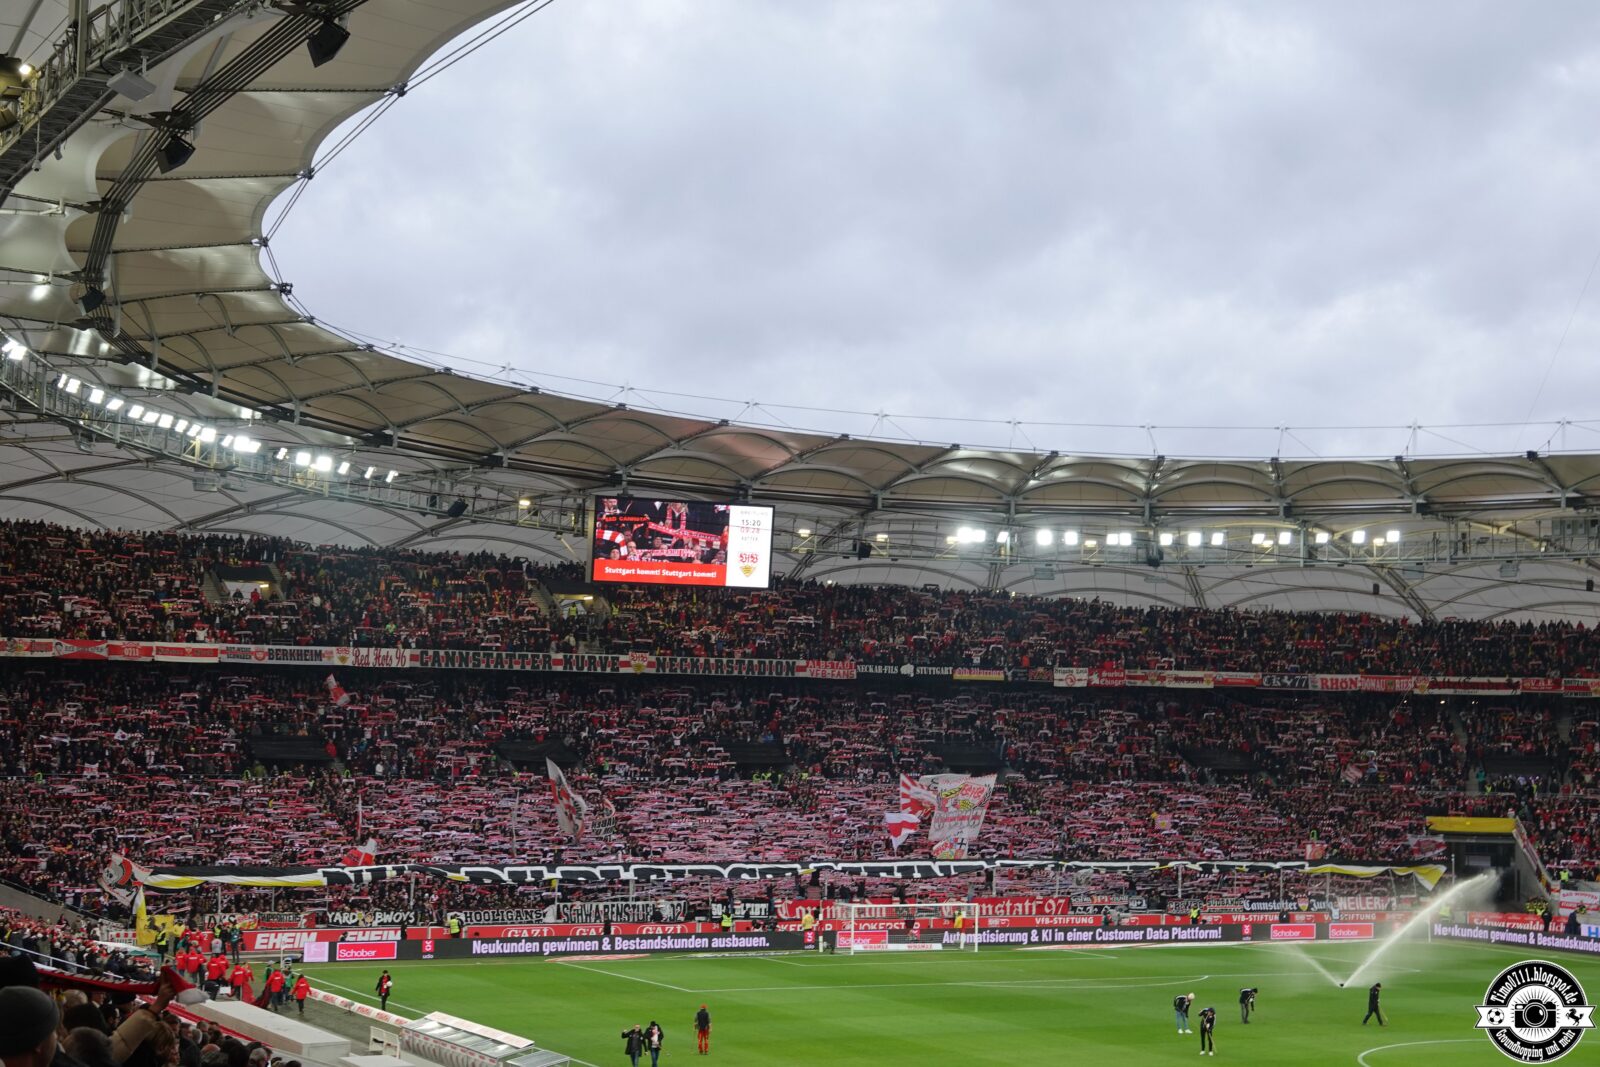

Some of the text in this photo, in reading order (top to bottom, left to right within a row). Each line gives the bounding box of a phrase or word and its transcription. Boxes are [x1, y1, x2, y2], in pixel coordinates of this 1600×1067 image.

[741, 519, 761, 528] 15:20
[604, 566, 635, 576] Stuttgart
[637, 568, 661, 576] kommt!
[662, 569, 692, 579] Stuttgart
[268, 648, 323, 662] BERKHEIM
[352, 647, 407, 667] Red Hots 96
[419, 650, 620, 672] CANNSTATTER KURVE
[656, 656, 797, 676] NECKARSTADION
[808, 660, 856, 669] ALBSTADT
[856, 664, 954, 675] NECKAR-FILS STUTTGART
[327, 911, 415, 925] YARD BWOYS
[463, 910, 542, 923] HOOLIGANS
[1034, 916, 1094, 926] VfB-STIFTUNG
[1231, 914, 1281, 923] VfB-STIFTUN
[943, 925, 1222, 945] Autmatisierung & KI in einer Customer Data Plattform!
[1272, 929, 1301, 938] Schober
[1331, 928, 1359, 937] Schober
[1434, 923, 1600, 953] Neukunden gewinnen & Bestandskunde
[254, 931, 318, 951] EHEIM
[472, 934, 770, 956] Neukunden gewinnen & Bestandskunden ausbauen.
[839, 936, 871, 945] Scober
[338, 949, 377, 959] Schober
